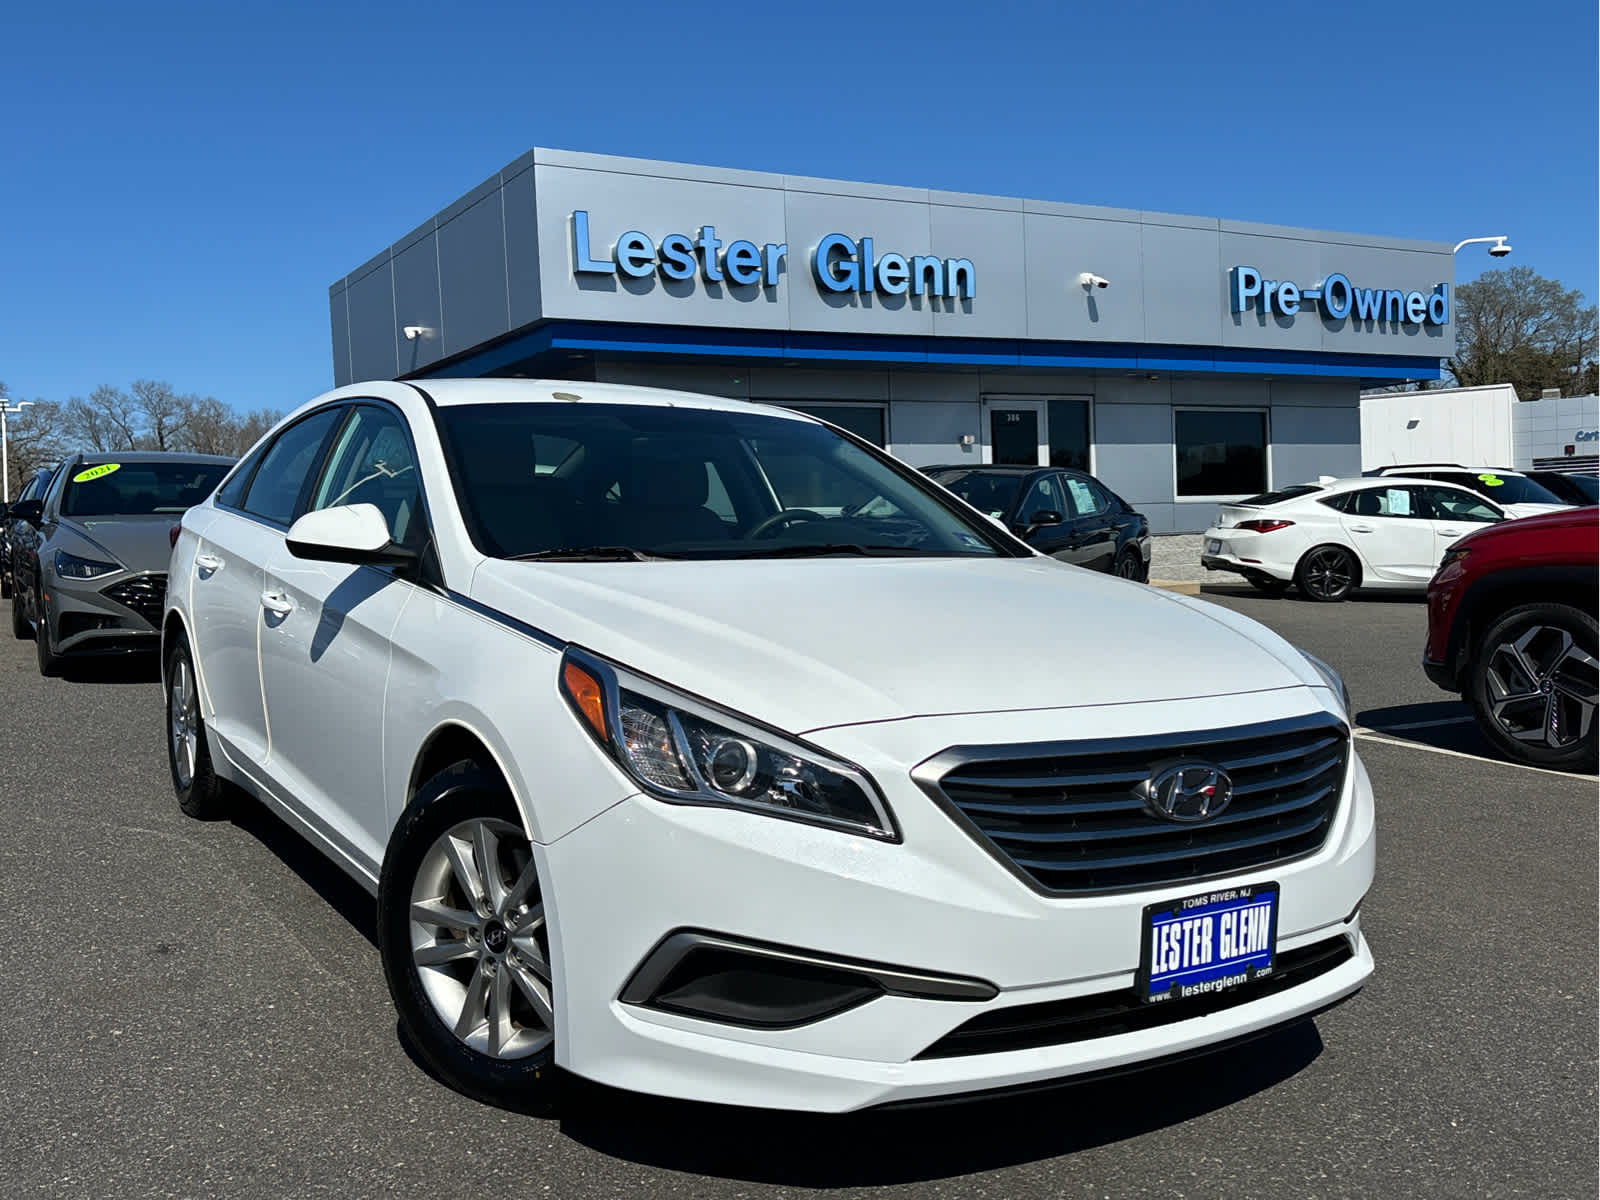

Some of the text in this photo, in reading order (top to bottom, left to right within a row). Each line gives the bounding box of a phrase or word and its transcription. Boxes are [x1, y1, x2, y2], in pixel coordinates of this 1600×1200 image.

[571, 210, 976, 298] Lester Glenn
[1230, 265, 1449, 325] Pre-Owned
[84, 465, 111, 479] 2021
[1182, 895, 1209, 909] TOMS
[1240, 888, 1251, 898] NJ
[1151, 905, 1271, 975] LESTER GLENN
[1181, 974, 1247, 997] lesterglenn
